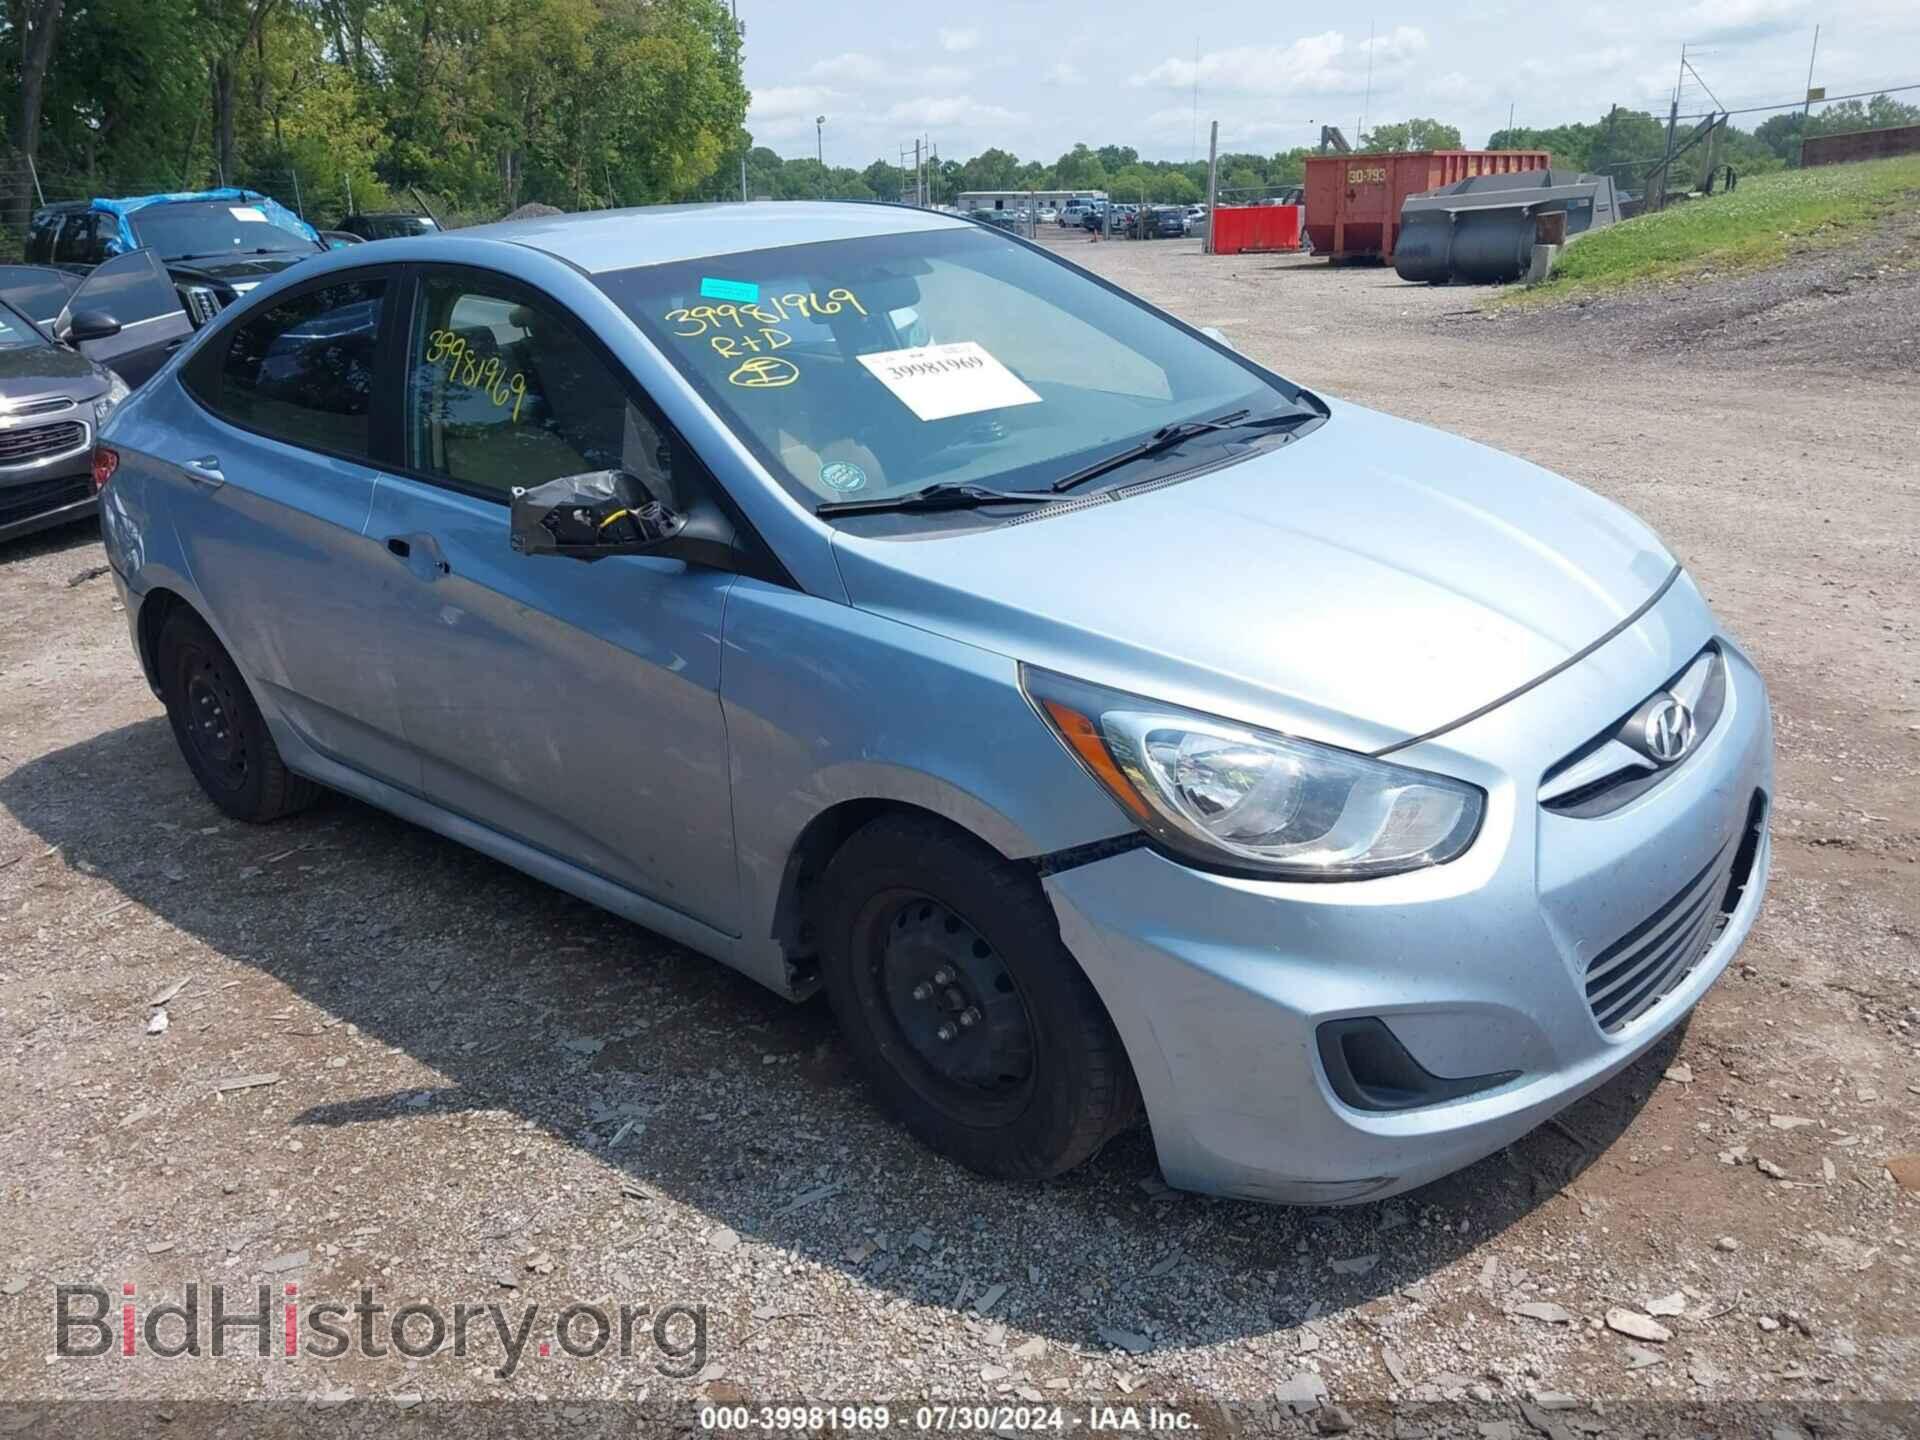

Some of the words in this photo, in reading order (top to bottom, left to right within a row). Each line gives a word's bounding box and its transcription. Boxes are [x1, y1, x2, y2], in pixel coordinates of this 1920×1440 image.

[664, 288, 868, 337] 39981969
[426, 329, 527, 423] 39981969
[888, 356, 984, 380] 39981969
